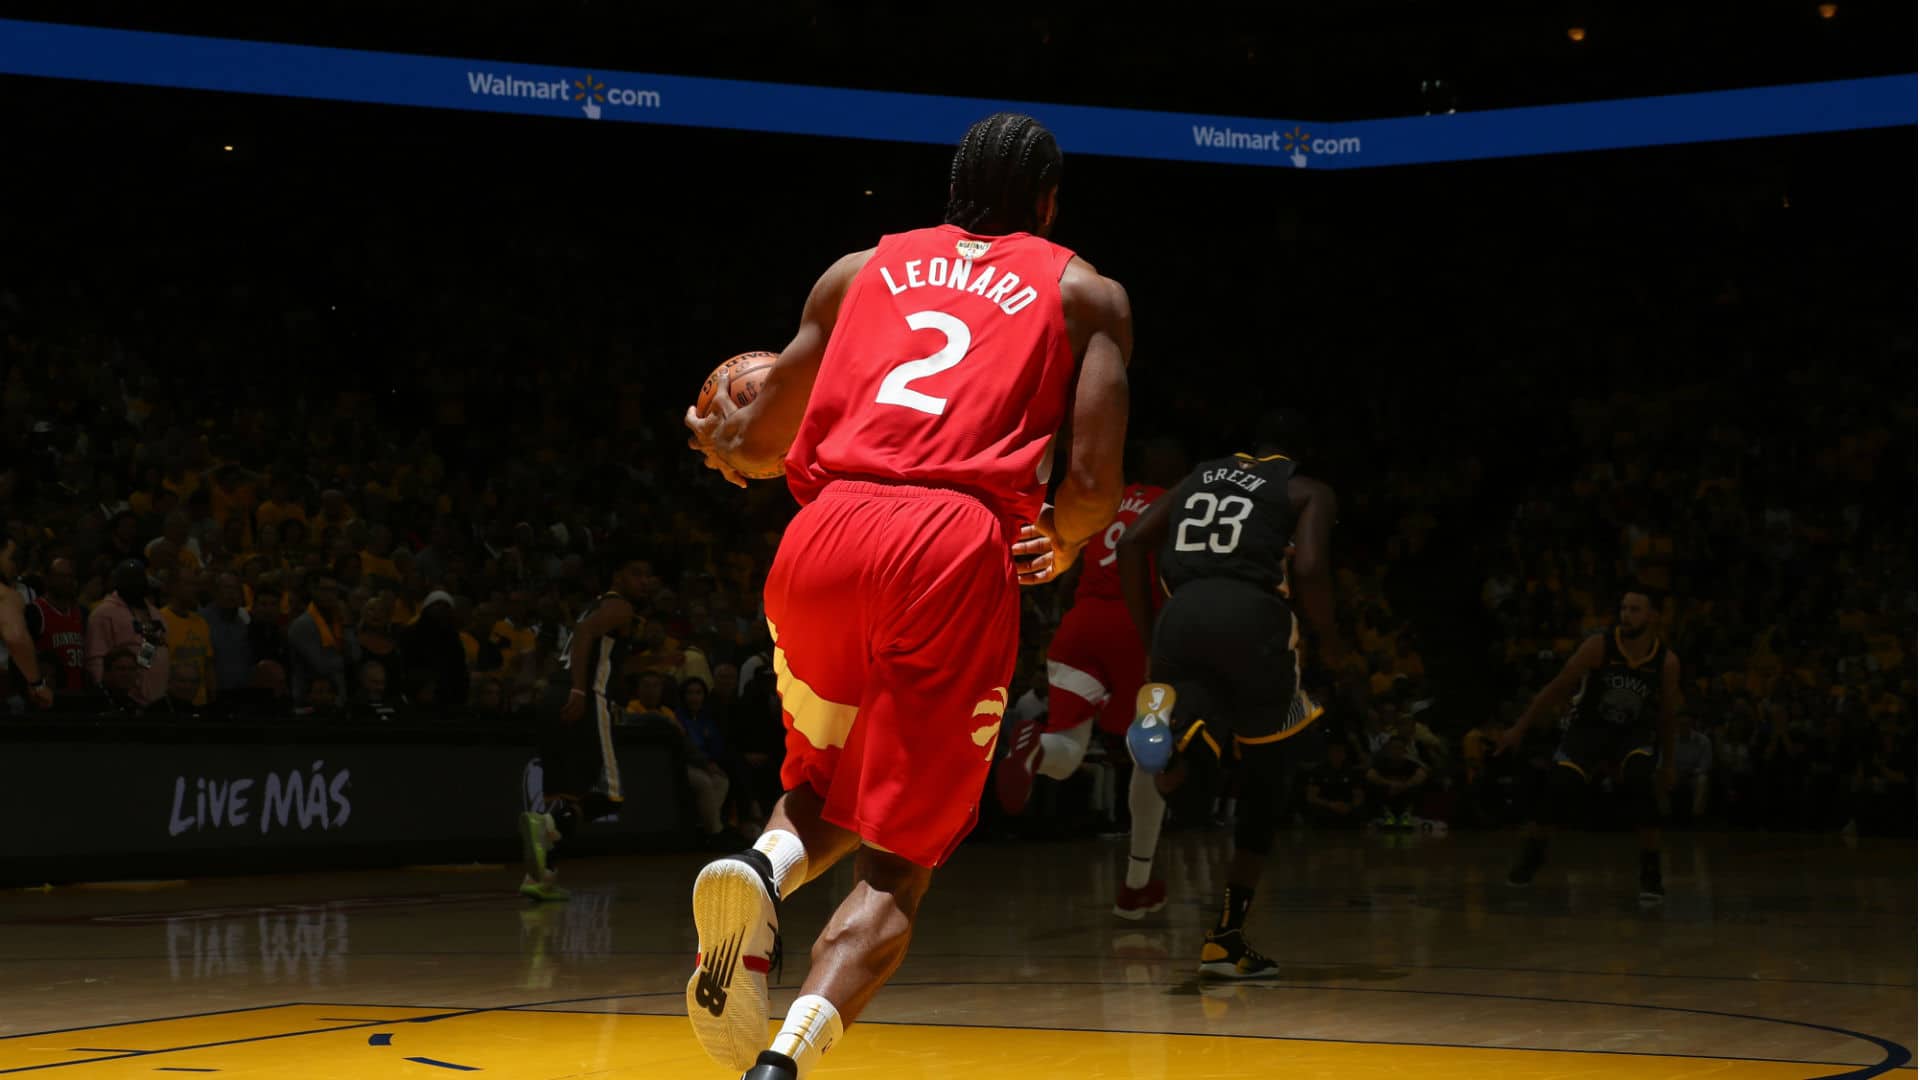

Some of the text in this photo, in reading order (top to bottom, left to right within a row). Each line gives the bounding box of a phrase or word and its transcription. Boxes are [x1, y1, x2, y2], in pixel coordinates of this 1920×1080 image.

[468, 72, 570, 100] Walmart
[1192, 125, 1280, 151] Walmart
[880, 257, 1037, 315] LEONARD
[875, 310, 971, 415] 2
[1203, 468, 1267, 492] GREEN
[1175, 492, 1254, 553] 23
[260, 760, 351, 835] MÁS
